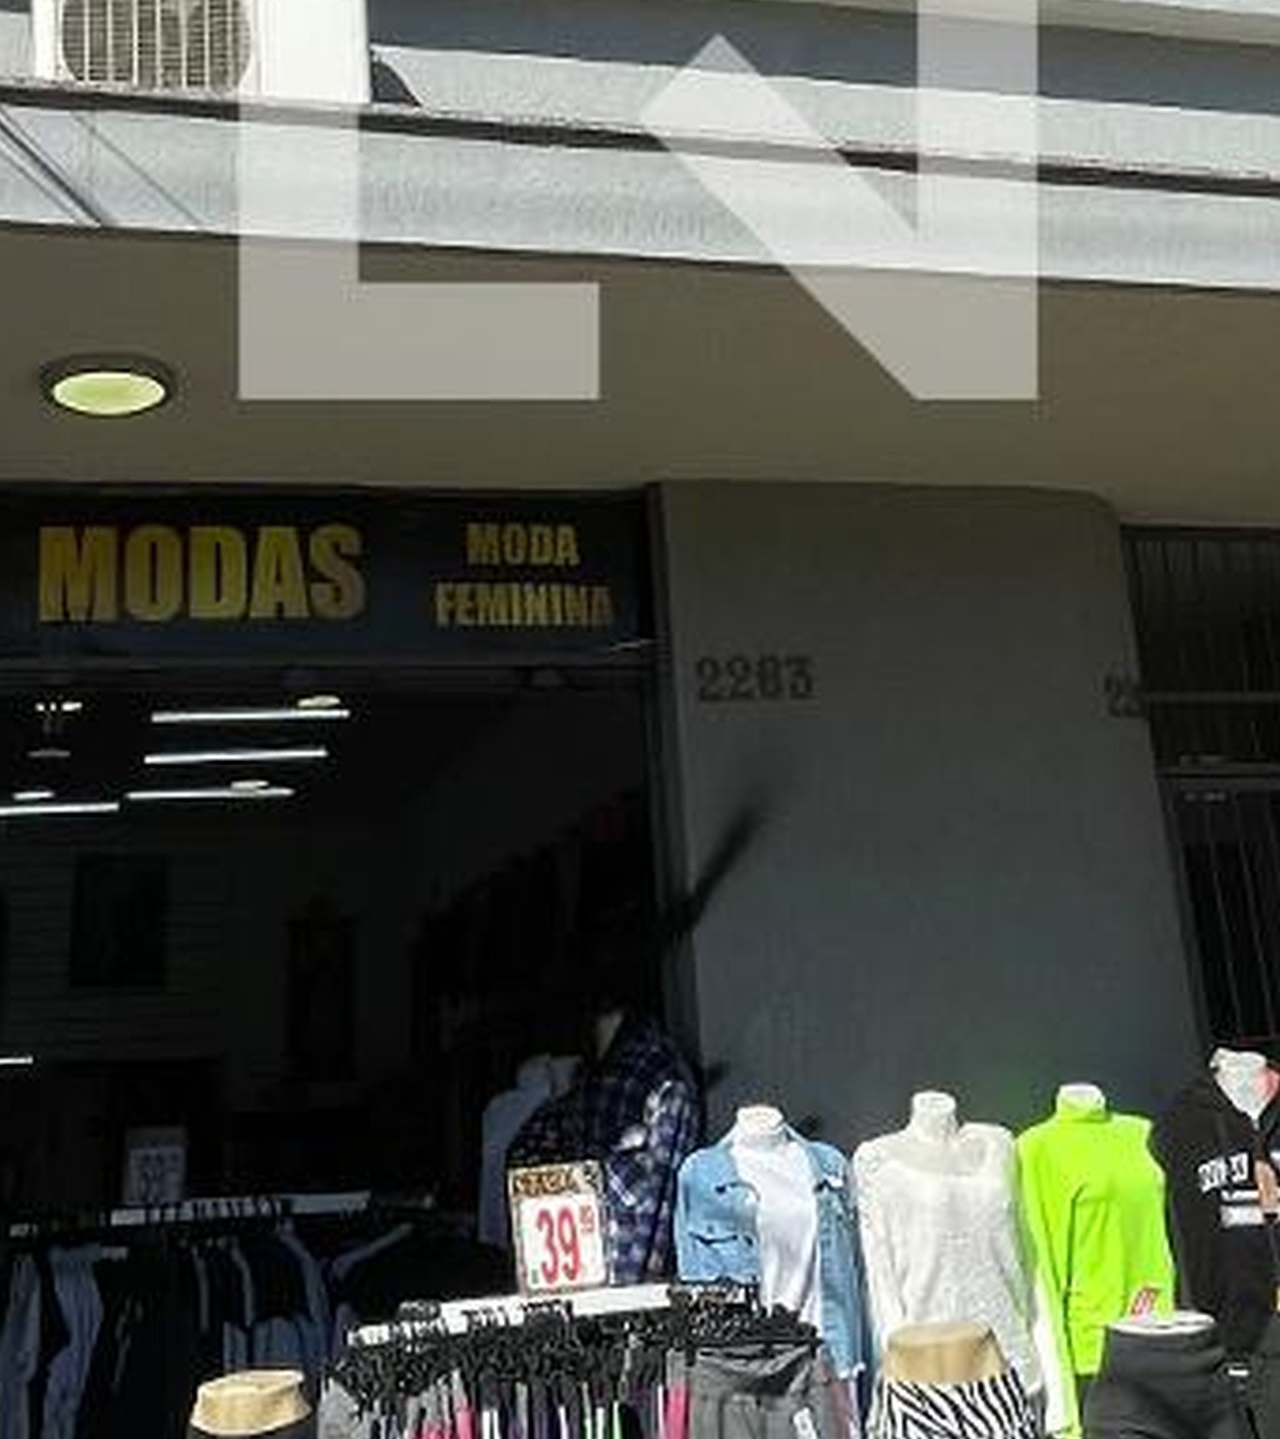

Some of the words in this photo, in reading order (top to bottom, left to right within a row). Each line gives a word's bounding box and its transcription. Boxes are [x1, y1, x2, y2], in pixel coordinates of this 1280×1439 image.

[38, 524, 367, 624] MODAS
[465, 522, 581, 566] MODA
[435, 581, 615, 627] FEMININA
[538, 1206, 580, 1284] 39
